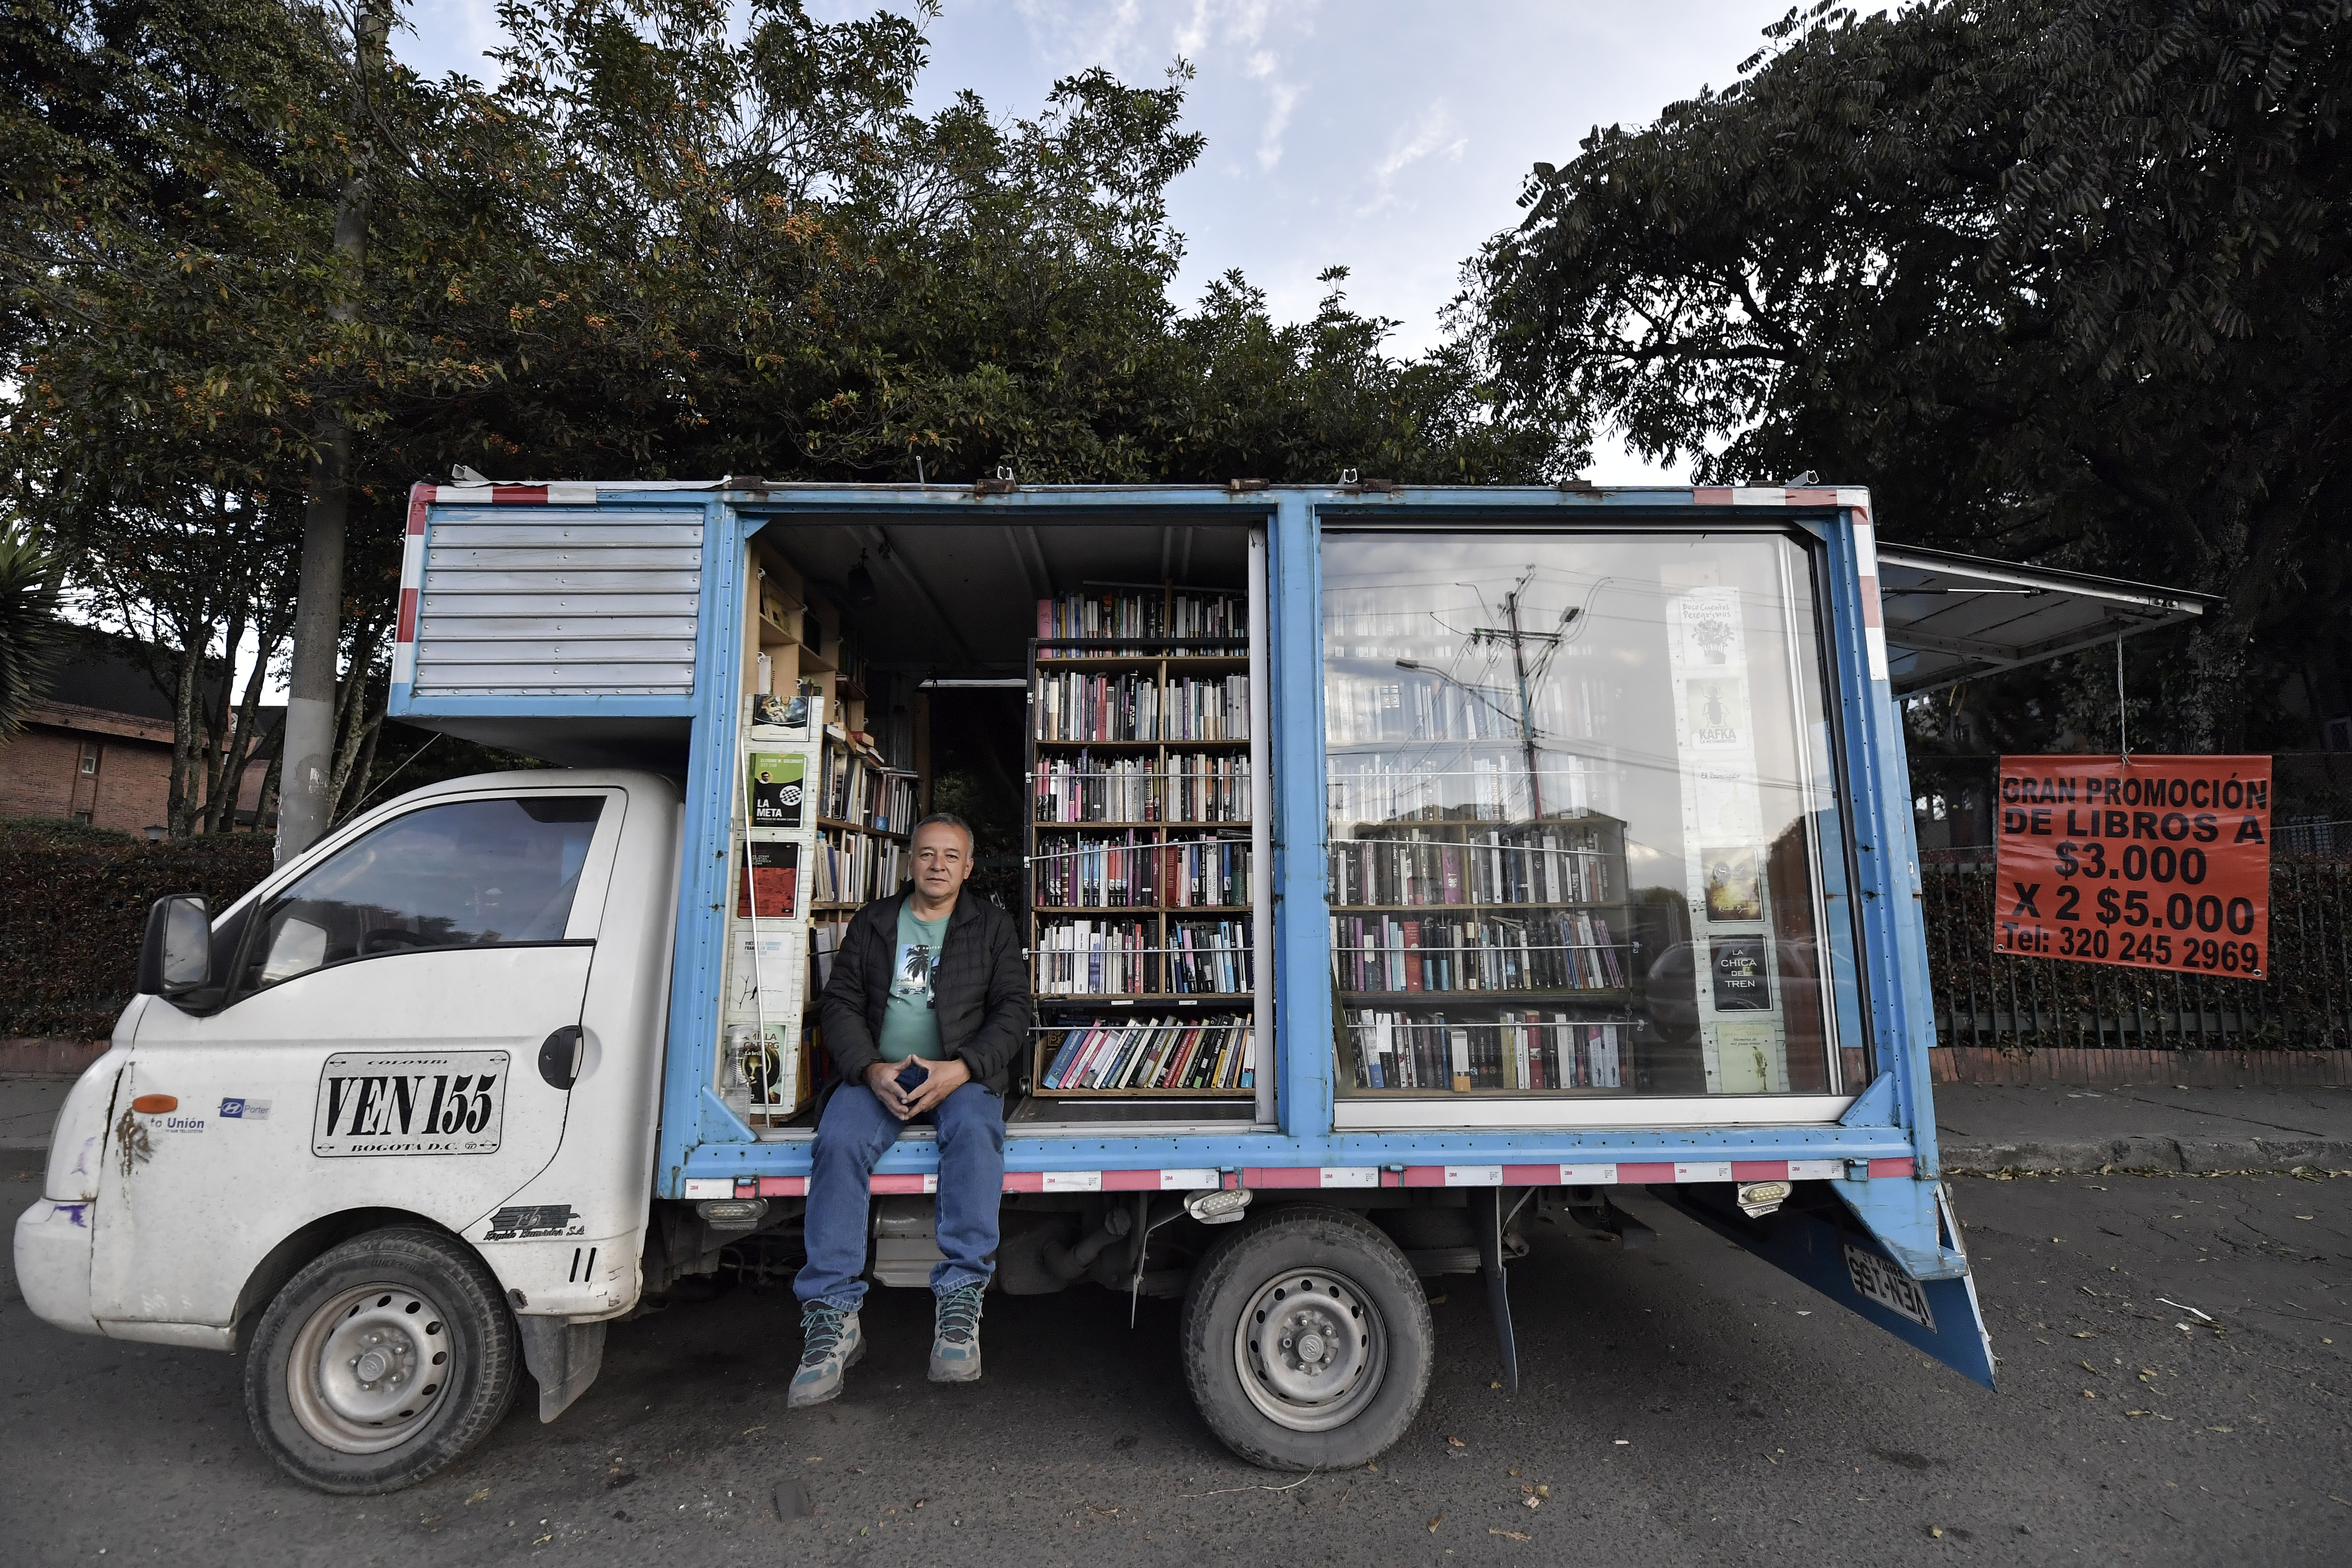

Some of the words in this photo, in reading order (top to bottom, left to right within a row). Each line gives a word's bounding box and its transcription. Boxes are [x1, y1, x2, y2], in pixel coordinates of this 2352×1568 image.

[1683, 611, 1731, 621] Peregrinos
[1699, 729, 1736, 739] KAFKA
[2002, 777, 2075, 803] GRAN
[2086, 773, 2267, 810] PROMOCIÓN
[757, 799, 769, 807] LA
[756, 808, 782, 817] META
[2005, 808, 2052, 836] DE
[2067, 809, 2219, 842] LIBROS
[2234, 815, 2265, 844] A
[2055, 840, 2206, 885] $3.000
[2011, 882, 2041, 918] X
[2055, 885, 2080, 921] 2
[2096, 886, 2255, 936] $5.000
[2002, 922, 2049, 953] Tel:
[2059, 926, 2109, 958] 320
[2119, 932, 2172, 965] 245
[2183, 937, 2258, 973] 2969
[1214, 1038, 1222, 1054] MENOS
[244, 1105, 269, 1114] Porter
[326, 1076, 426, 1136] VEN
[421, 1074, 497, 1134] 155
[168, 1117, 204, 1128] Unión
[351, 1143, 422, 1152] BOGOTA
[427, 1143, 458, 1151] D.C.
